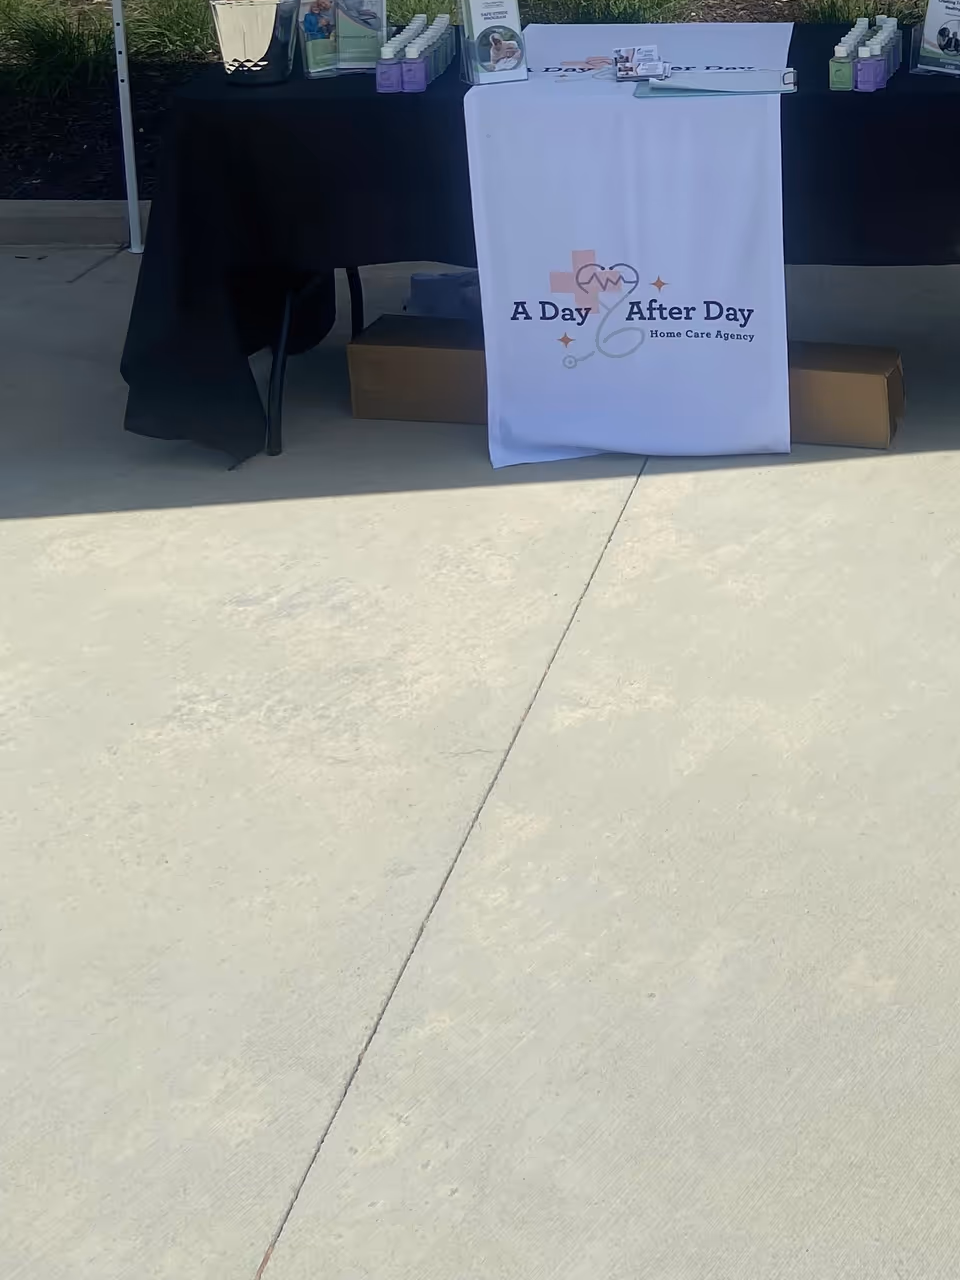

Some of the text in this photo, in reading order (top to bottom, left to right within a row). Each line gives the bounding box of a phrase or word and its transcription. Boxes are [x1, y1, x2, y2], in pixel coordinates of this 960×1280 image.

[510, 299, 754, 328] A Day After Day
[650, 330, 755, 342] Home Care Agency
